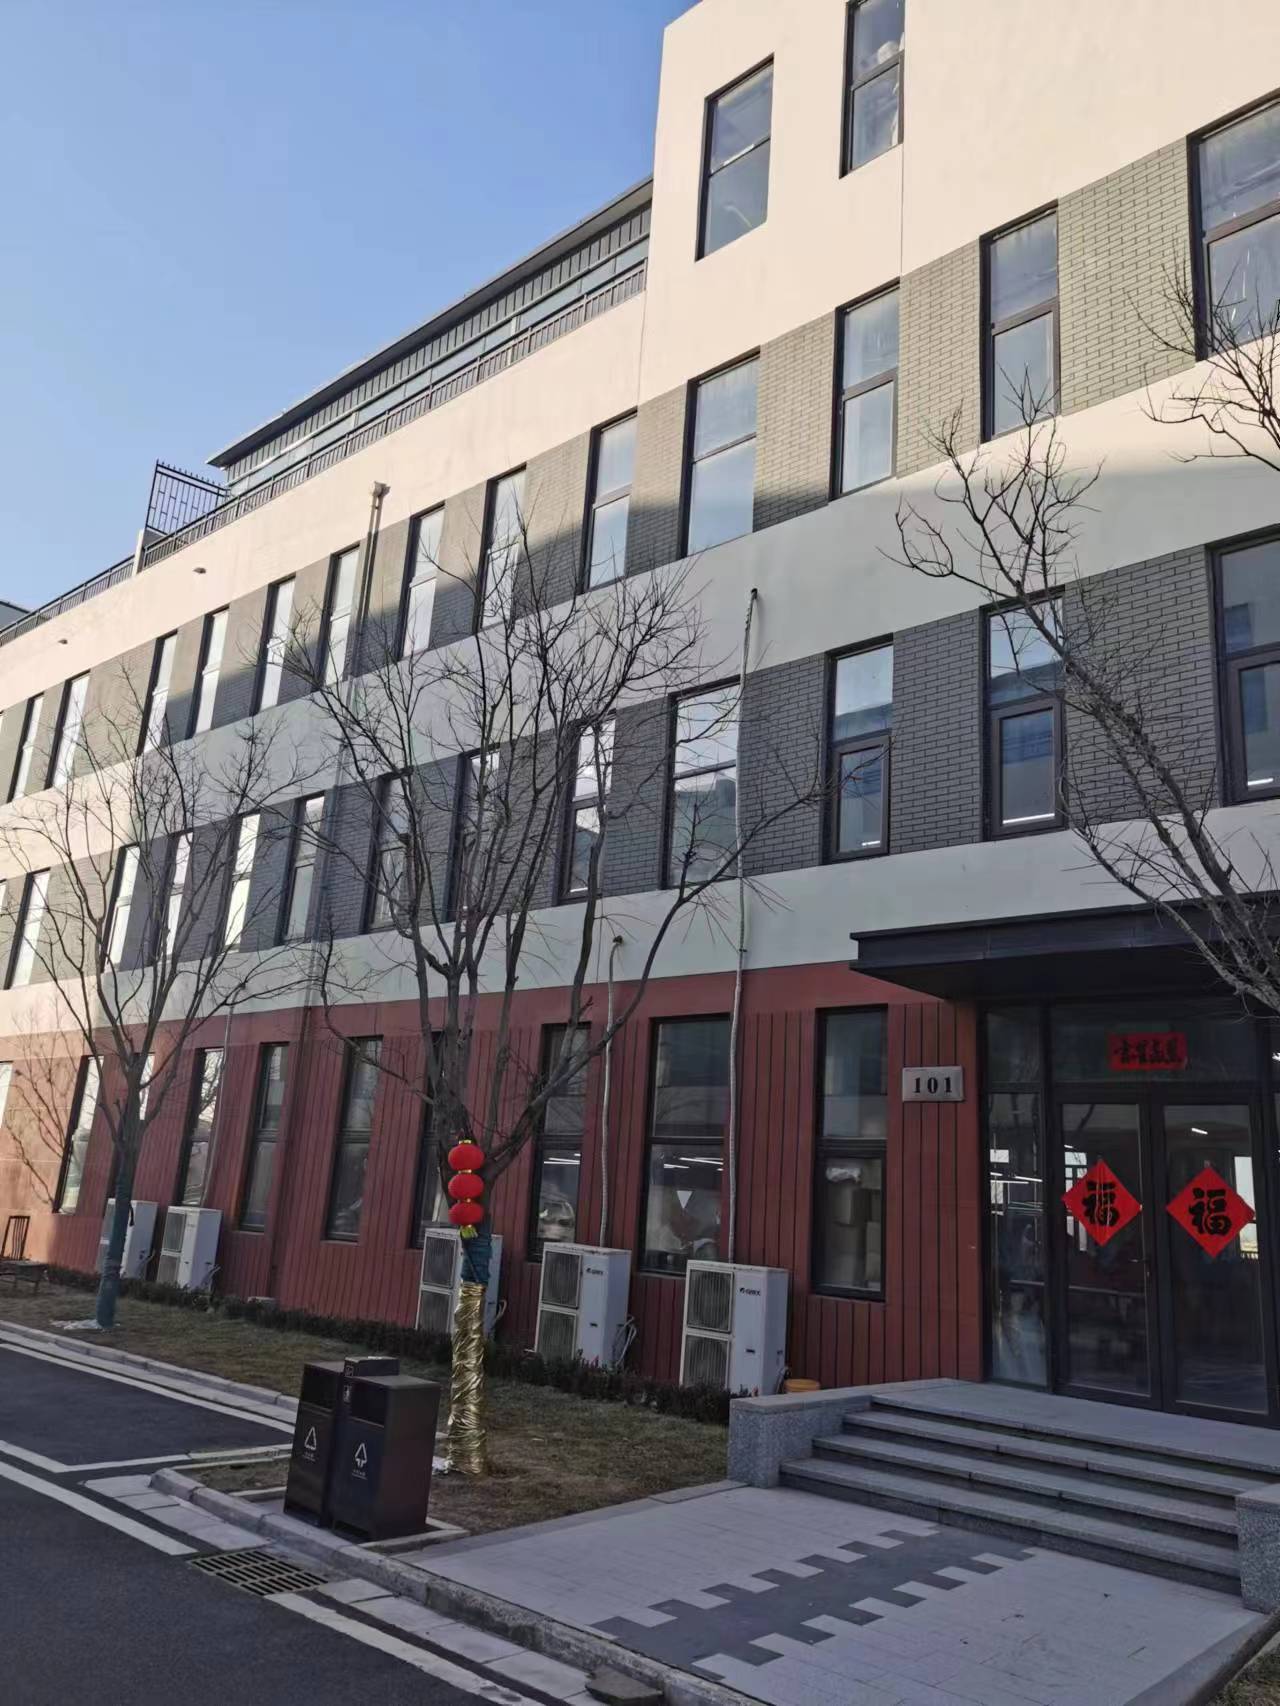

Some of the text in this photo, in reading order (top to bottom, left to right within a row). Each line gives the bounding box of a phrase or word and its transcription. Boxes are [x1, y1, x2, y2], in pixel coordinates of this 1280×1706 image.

[912, 1076, 953, 1095] 101
[1081, 1180, 1121, 1227] 福
[1188, 1187, 1233, 1237] 福
